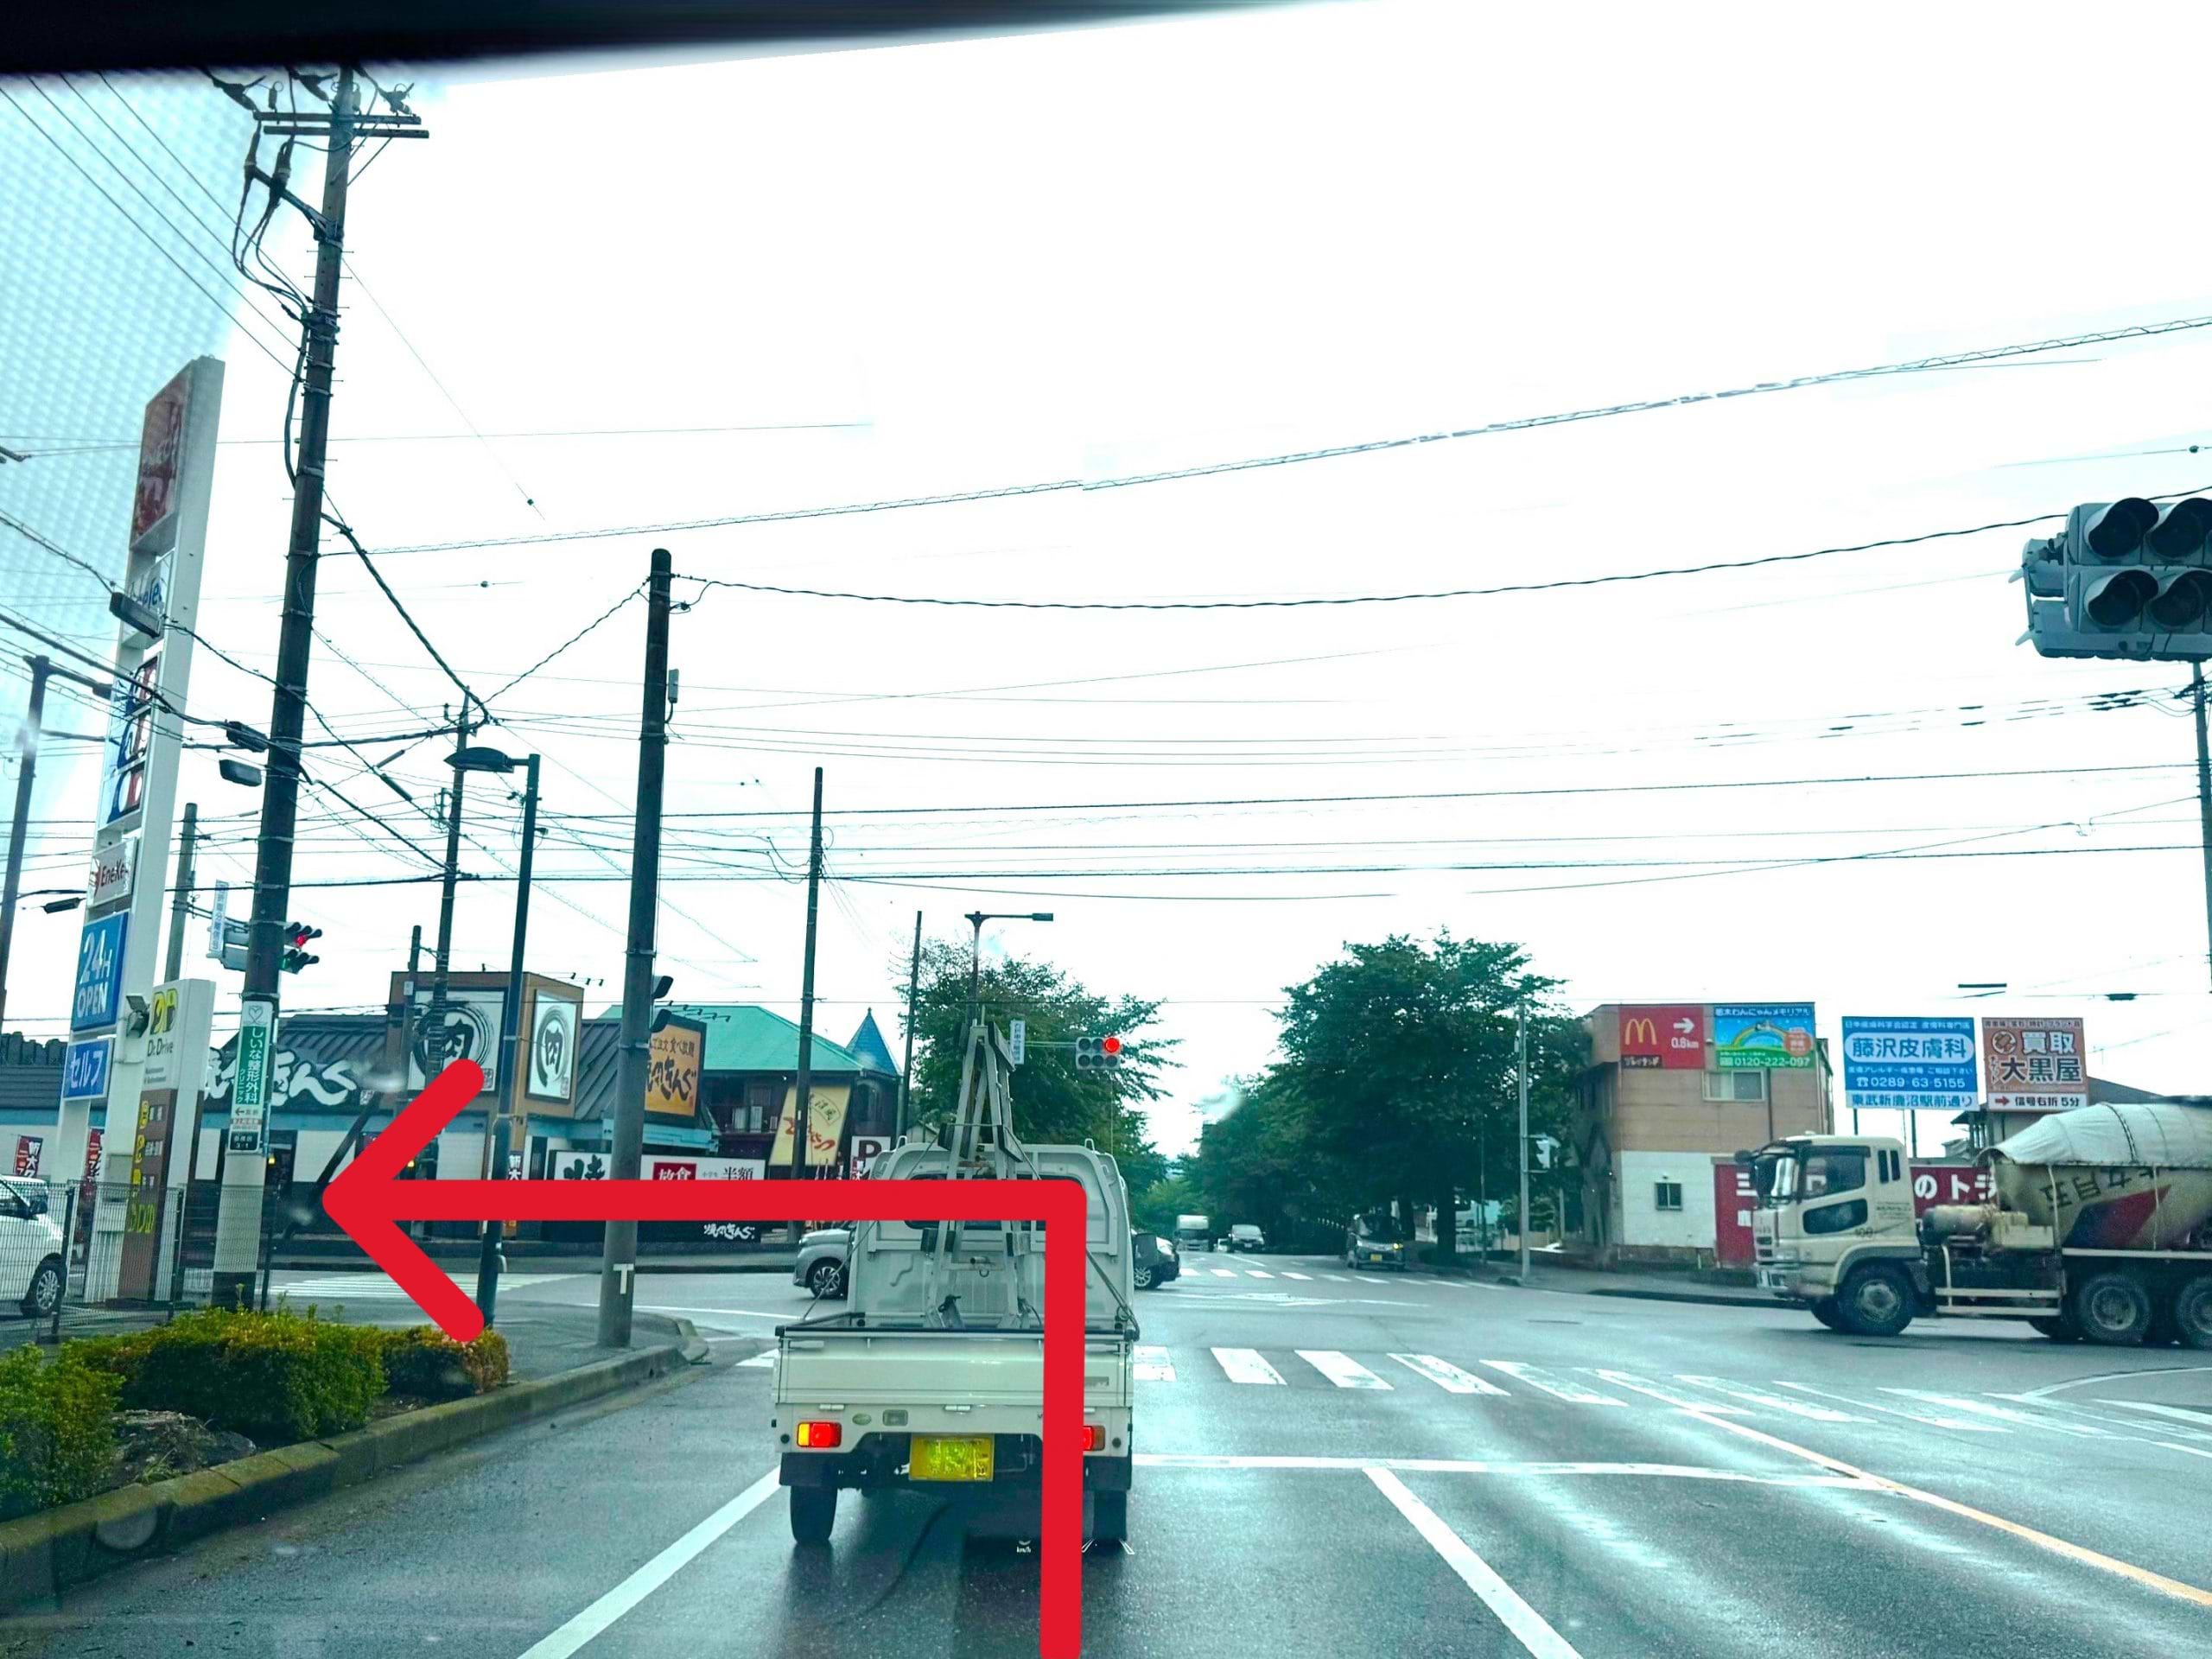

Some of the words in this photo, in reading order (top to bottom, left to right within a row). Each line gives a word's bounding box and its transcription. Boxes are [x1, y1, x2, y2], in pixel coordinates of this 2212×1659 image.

[79, 930, 112, 983] 24H
[77, 982, 108, 1018] OPEN
[1853, 1038, 1967, 1058] 藤沢皮膚科
[2022, 1031, 2075, 1055] 買取
[68, 1050, 104, 1089] セルフ
[245, 1027, 264, 1103] しいな整形外科
[1734, 1057, 1810, 1066] 0120-222-097
[1999, 1056, 2083, 1084] 大黒屋
[1852, 1094, 1973, 1107] 東武新鹿沼駅前通り
[858, 1140, 881, 1169] P
